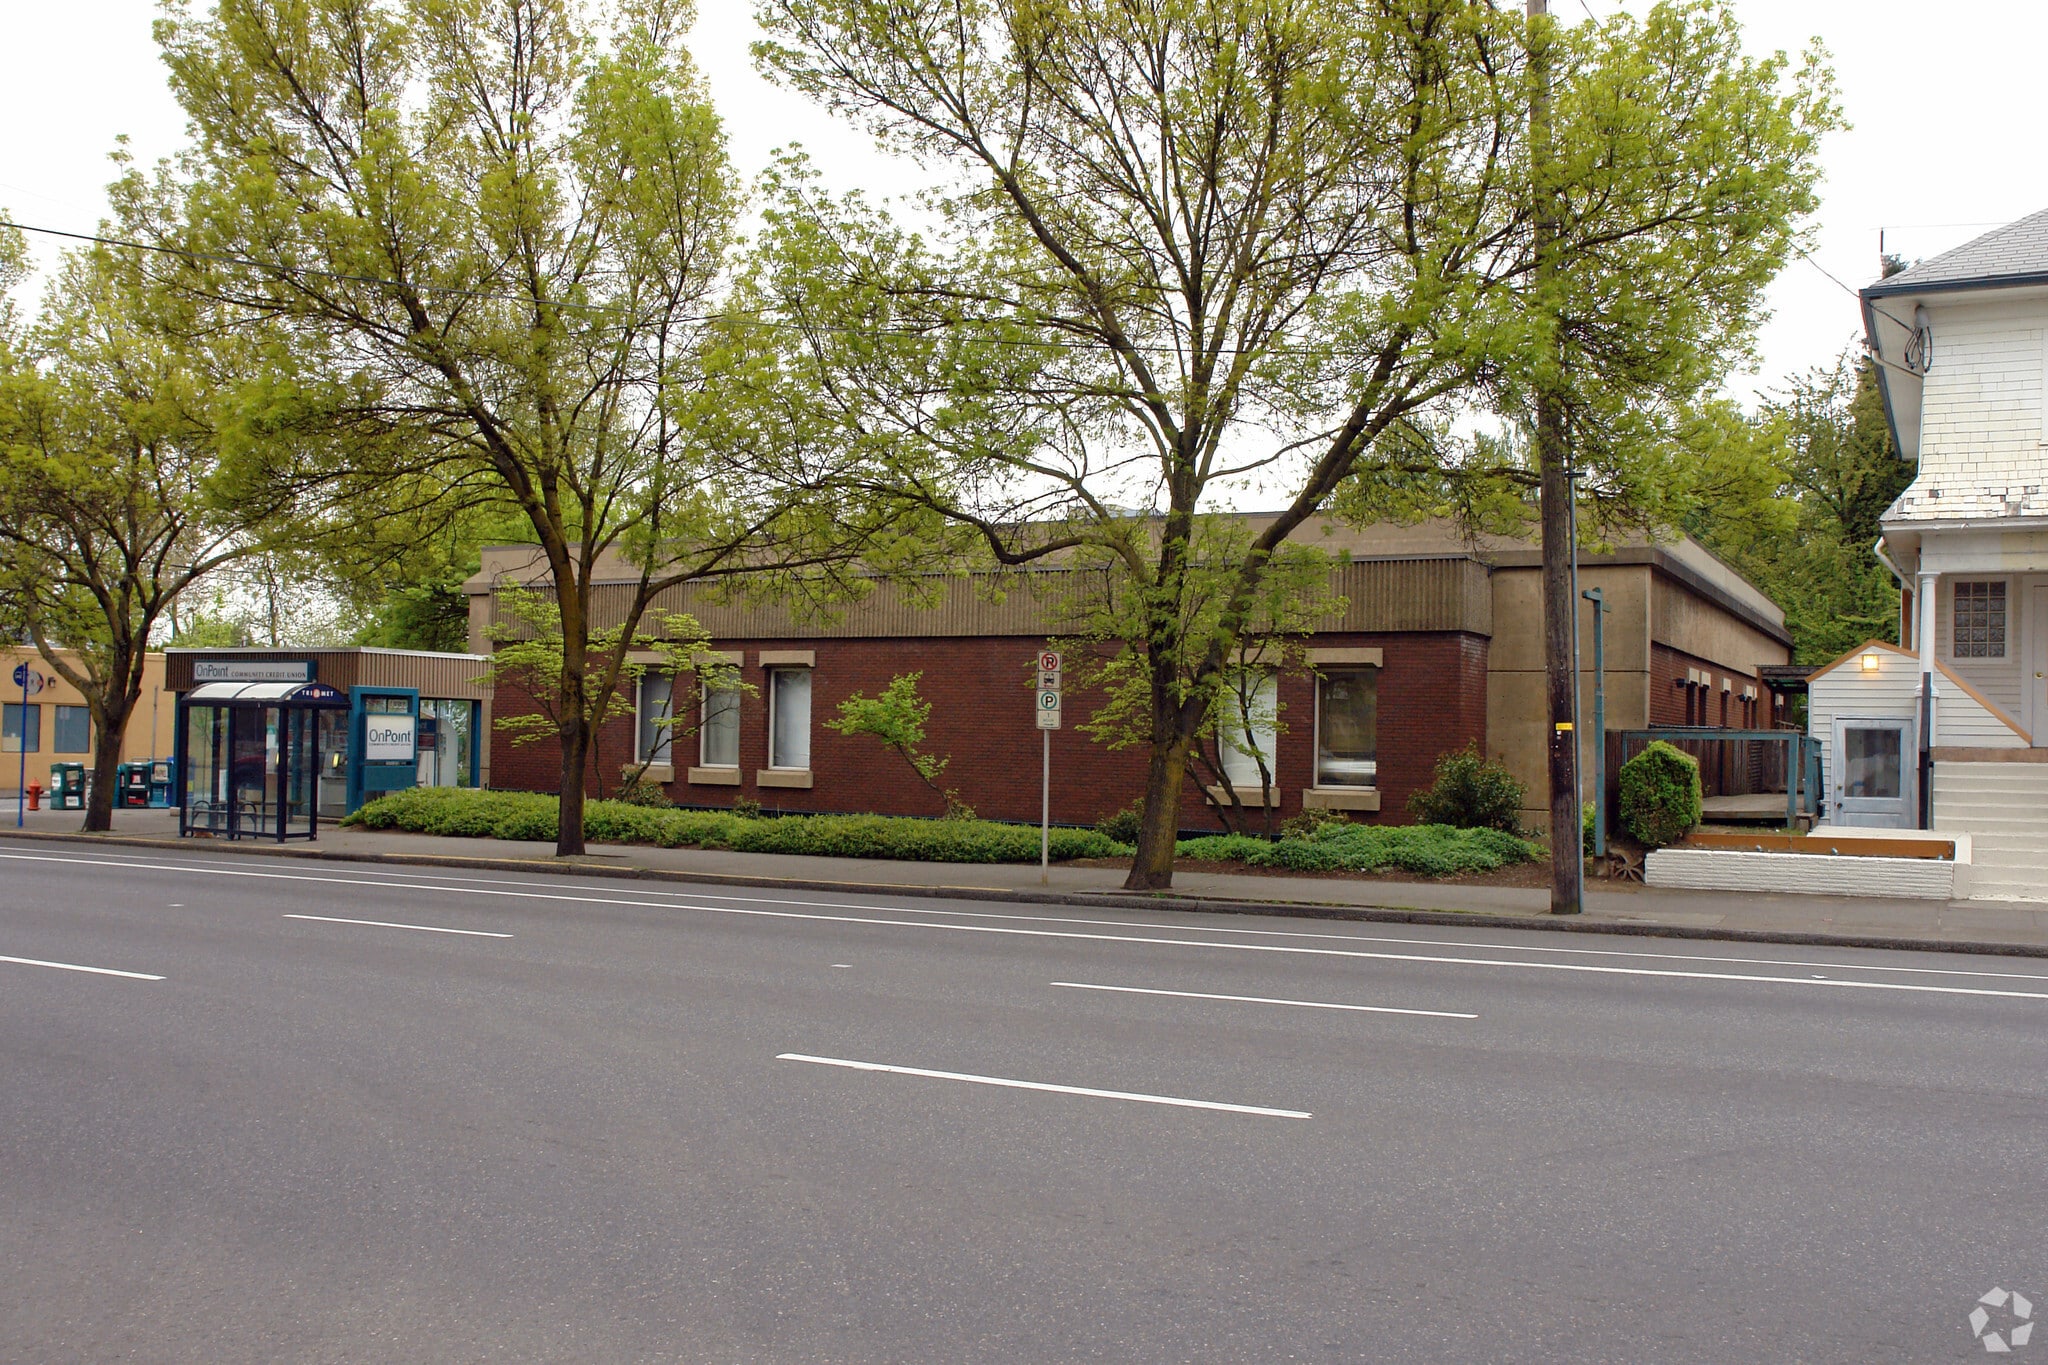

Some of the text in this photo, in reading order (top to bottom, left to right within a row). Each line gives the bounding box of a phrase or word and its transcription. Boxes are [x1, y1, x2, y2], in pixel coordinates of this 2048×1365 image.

[196, 664, 229, 678] OnPoint
[286, 671, 306, 679] UNION
[1045, 696, 1053, 706] P
[369, 728, 411, 743] OnPoint
